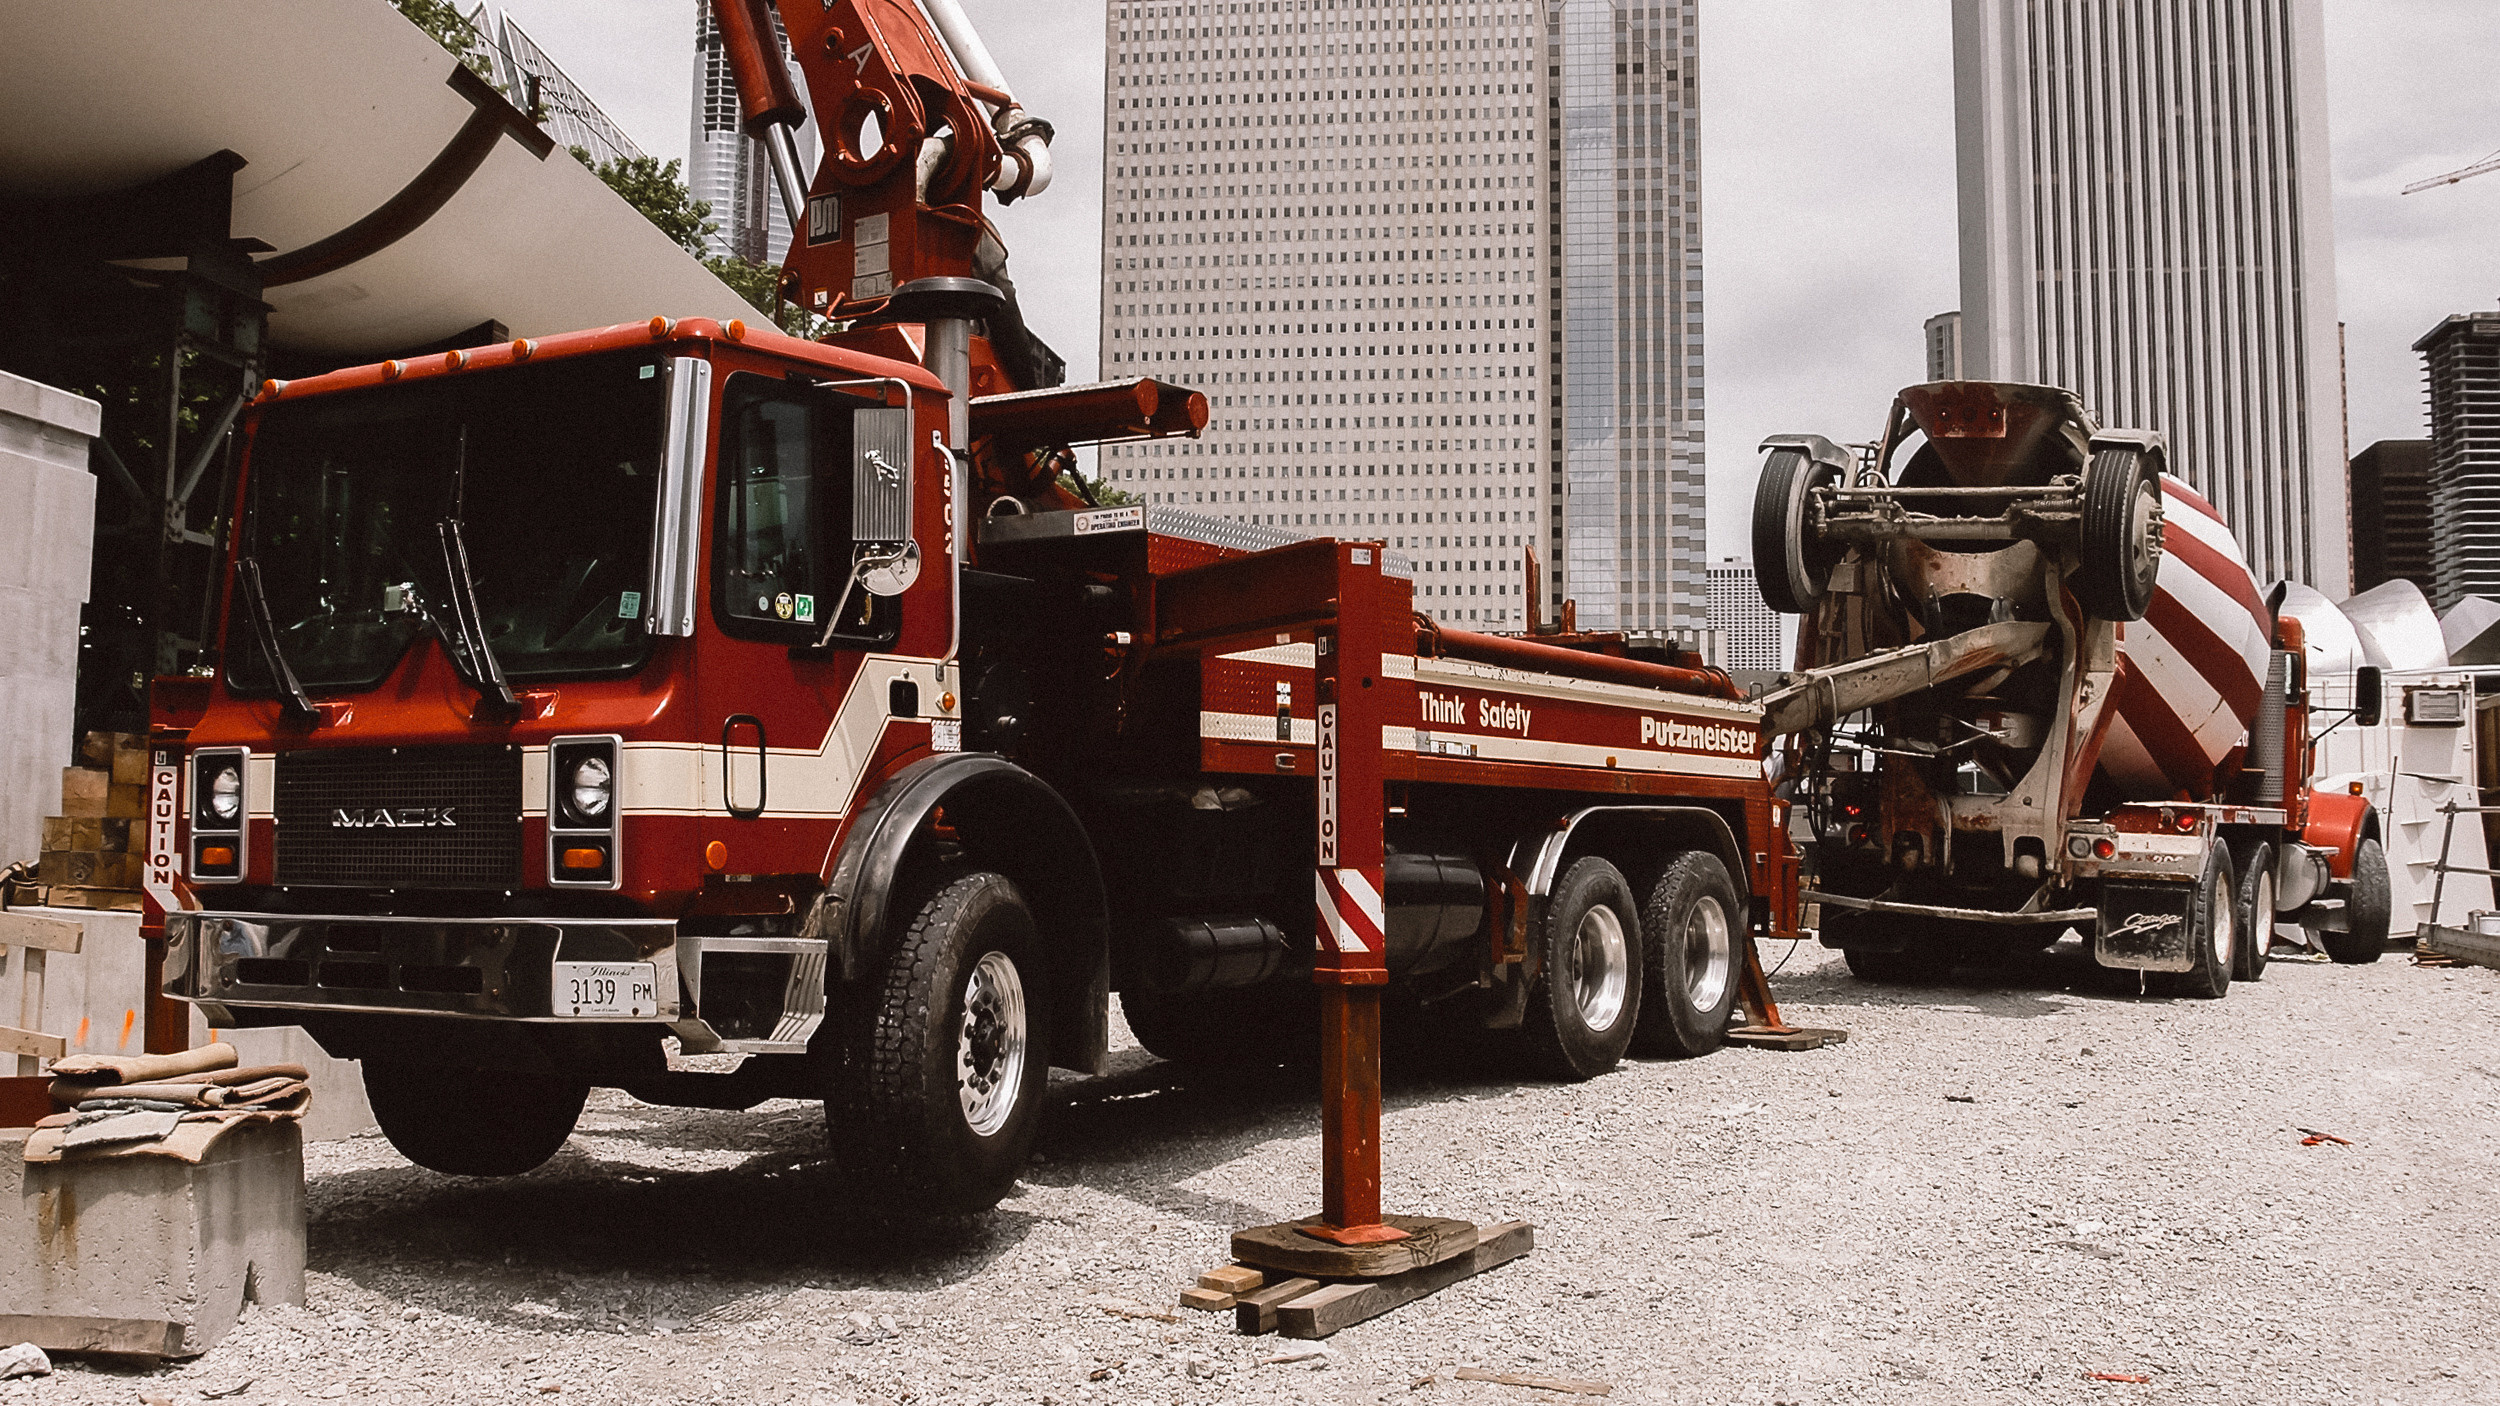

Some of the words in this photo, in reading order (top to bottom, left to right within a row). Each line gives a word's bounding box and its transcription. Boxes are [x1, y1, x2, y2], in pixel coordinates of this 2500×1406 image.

[847, 42, 874, 75] A
[1419, 691, 1465, 725] Think
[1479, 698, 1531, 737] Safety
[1641, 716, 1756, 754] Putzmeister
[1321, 711, 1334, 859] CAUTION
[153, 772, 173, 884] CAUTION
[332, 807, 456, 827] MACK
[591, 965, 631, 977] Illinois
[570, 979, 615, 1005] 3139
[633, 984, 652, 1000] PM
